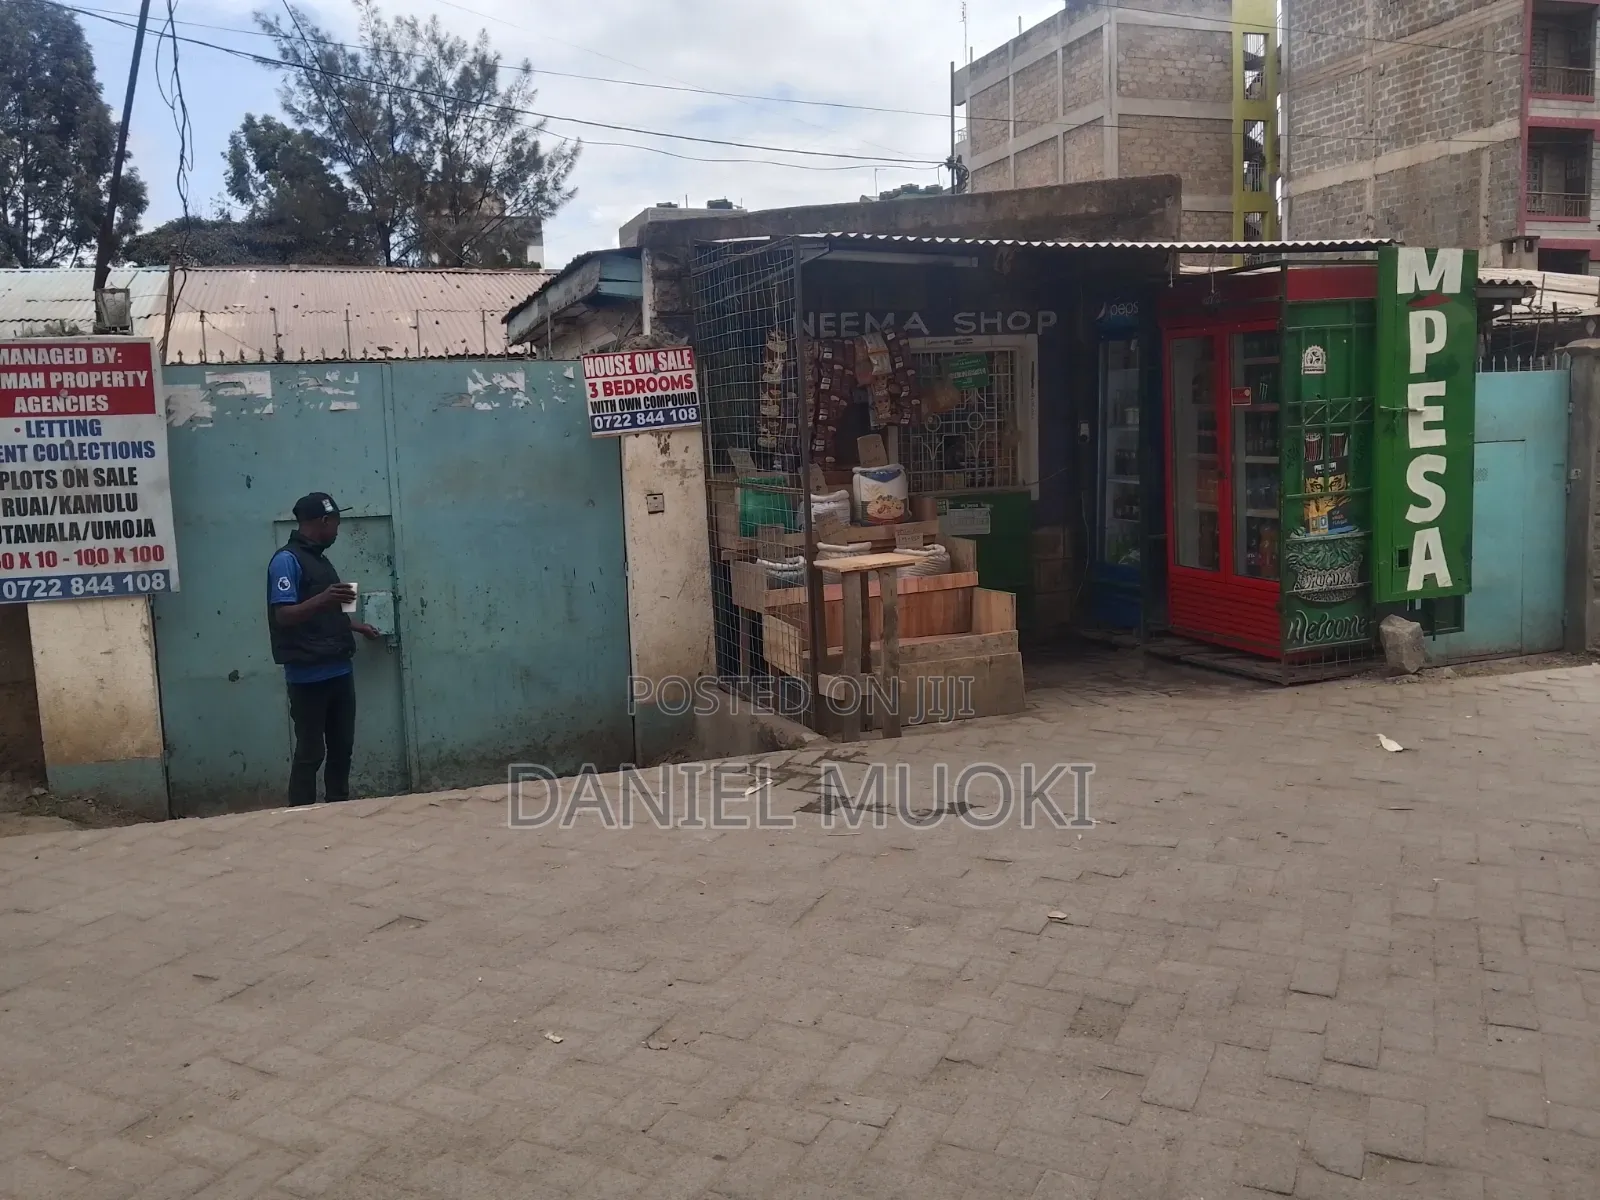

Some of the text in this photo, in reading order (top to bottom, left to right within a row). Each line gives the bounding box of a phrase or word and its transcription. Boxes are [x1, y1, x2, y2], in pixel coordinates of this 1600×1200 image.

[801, 310, 1058, 338] NEEMA SHOP
[92, 346, 123, 364] BY:
[583, 349, 692, 378] HOUSE ON SALE
[0, 370, 149, 389] MAH PROPERTY
[588, 373, 694, 398] 3 BEDROOMS
[14, 394, 109, 414] AGENCIES
[590, 391, 698, 414] WITH OWN COMPOUND
[25, 419, 102, 438] LETTING
[594, 407, 697, 429] 0722 844 108
[33, 440, 156, 462] COLLECTIONS
[0, 466, 138, 491] PLOTS ON SALE
[2, 492, 139, 517] RUAI/KAMULU
[0, 518, 156, 545] TAWALA/UMOJA
[0, 552, 15, 570] 0
[19, 552, 32, 569] X
[35, 550, 58, 568] 10
[74, 547, 109, 566] 100
[114, 546, 126, 564] X
[129, 544, 165, 563] 100
[2, 572, 166, 600] 0722 844 108
